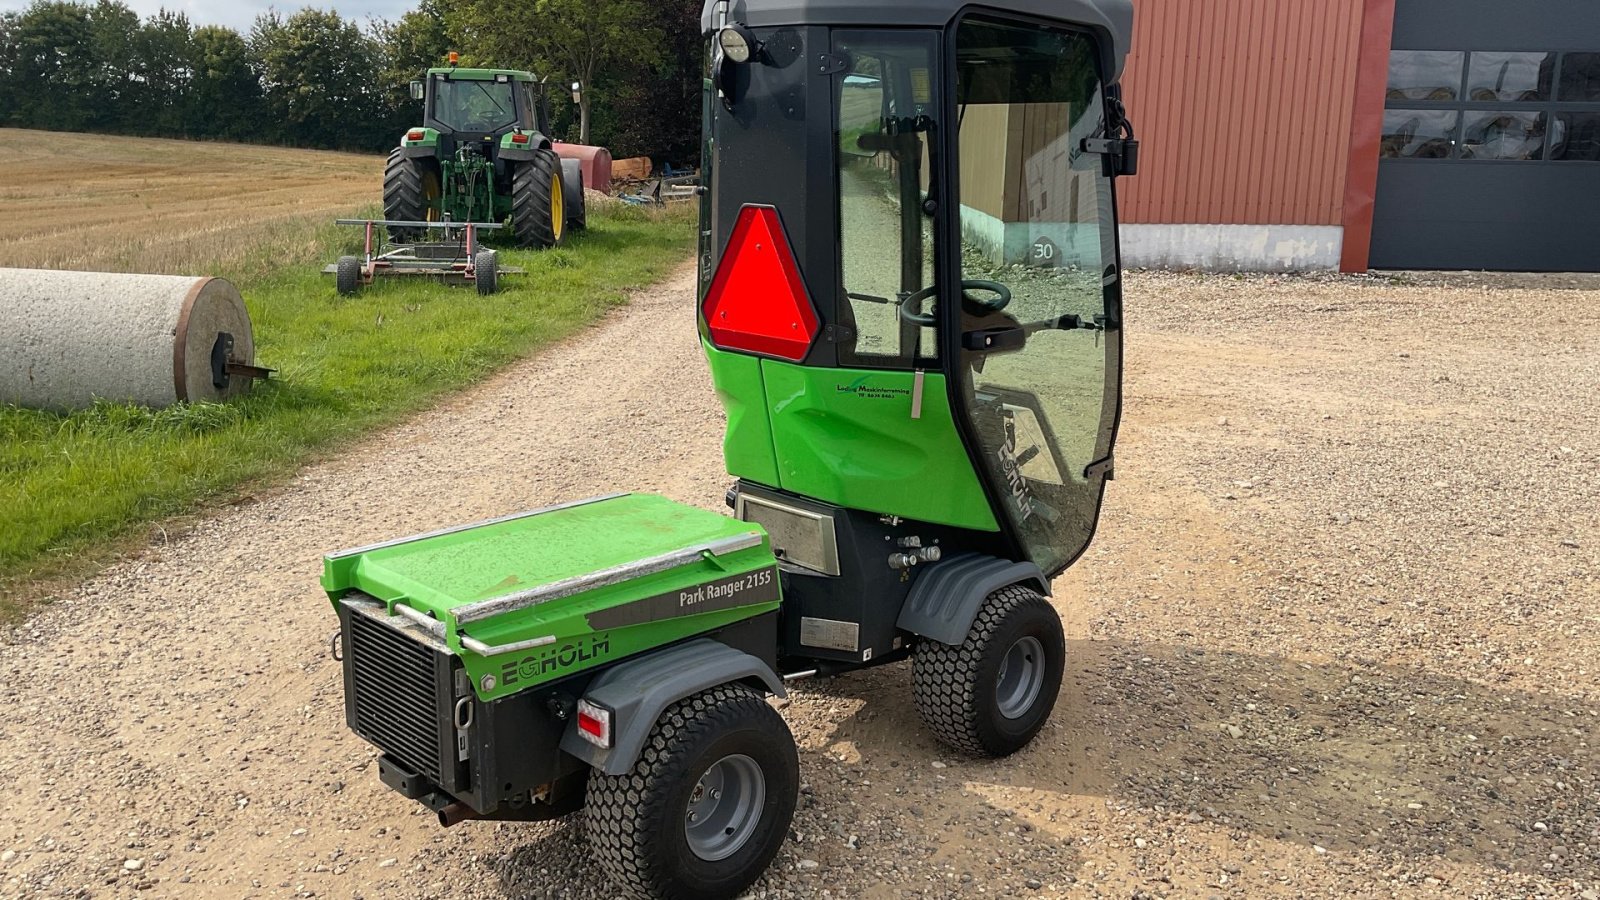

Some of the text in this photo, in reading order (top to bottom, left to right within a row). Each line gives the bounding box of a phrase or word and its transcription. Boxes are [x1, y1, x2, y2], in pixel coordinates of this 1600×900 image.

[1034, 243, 1053, 259] 30
[680, 570, 771, 607] Park Ranger 2155
[501, 633, 609, 687] EGHOLM
